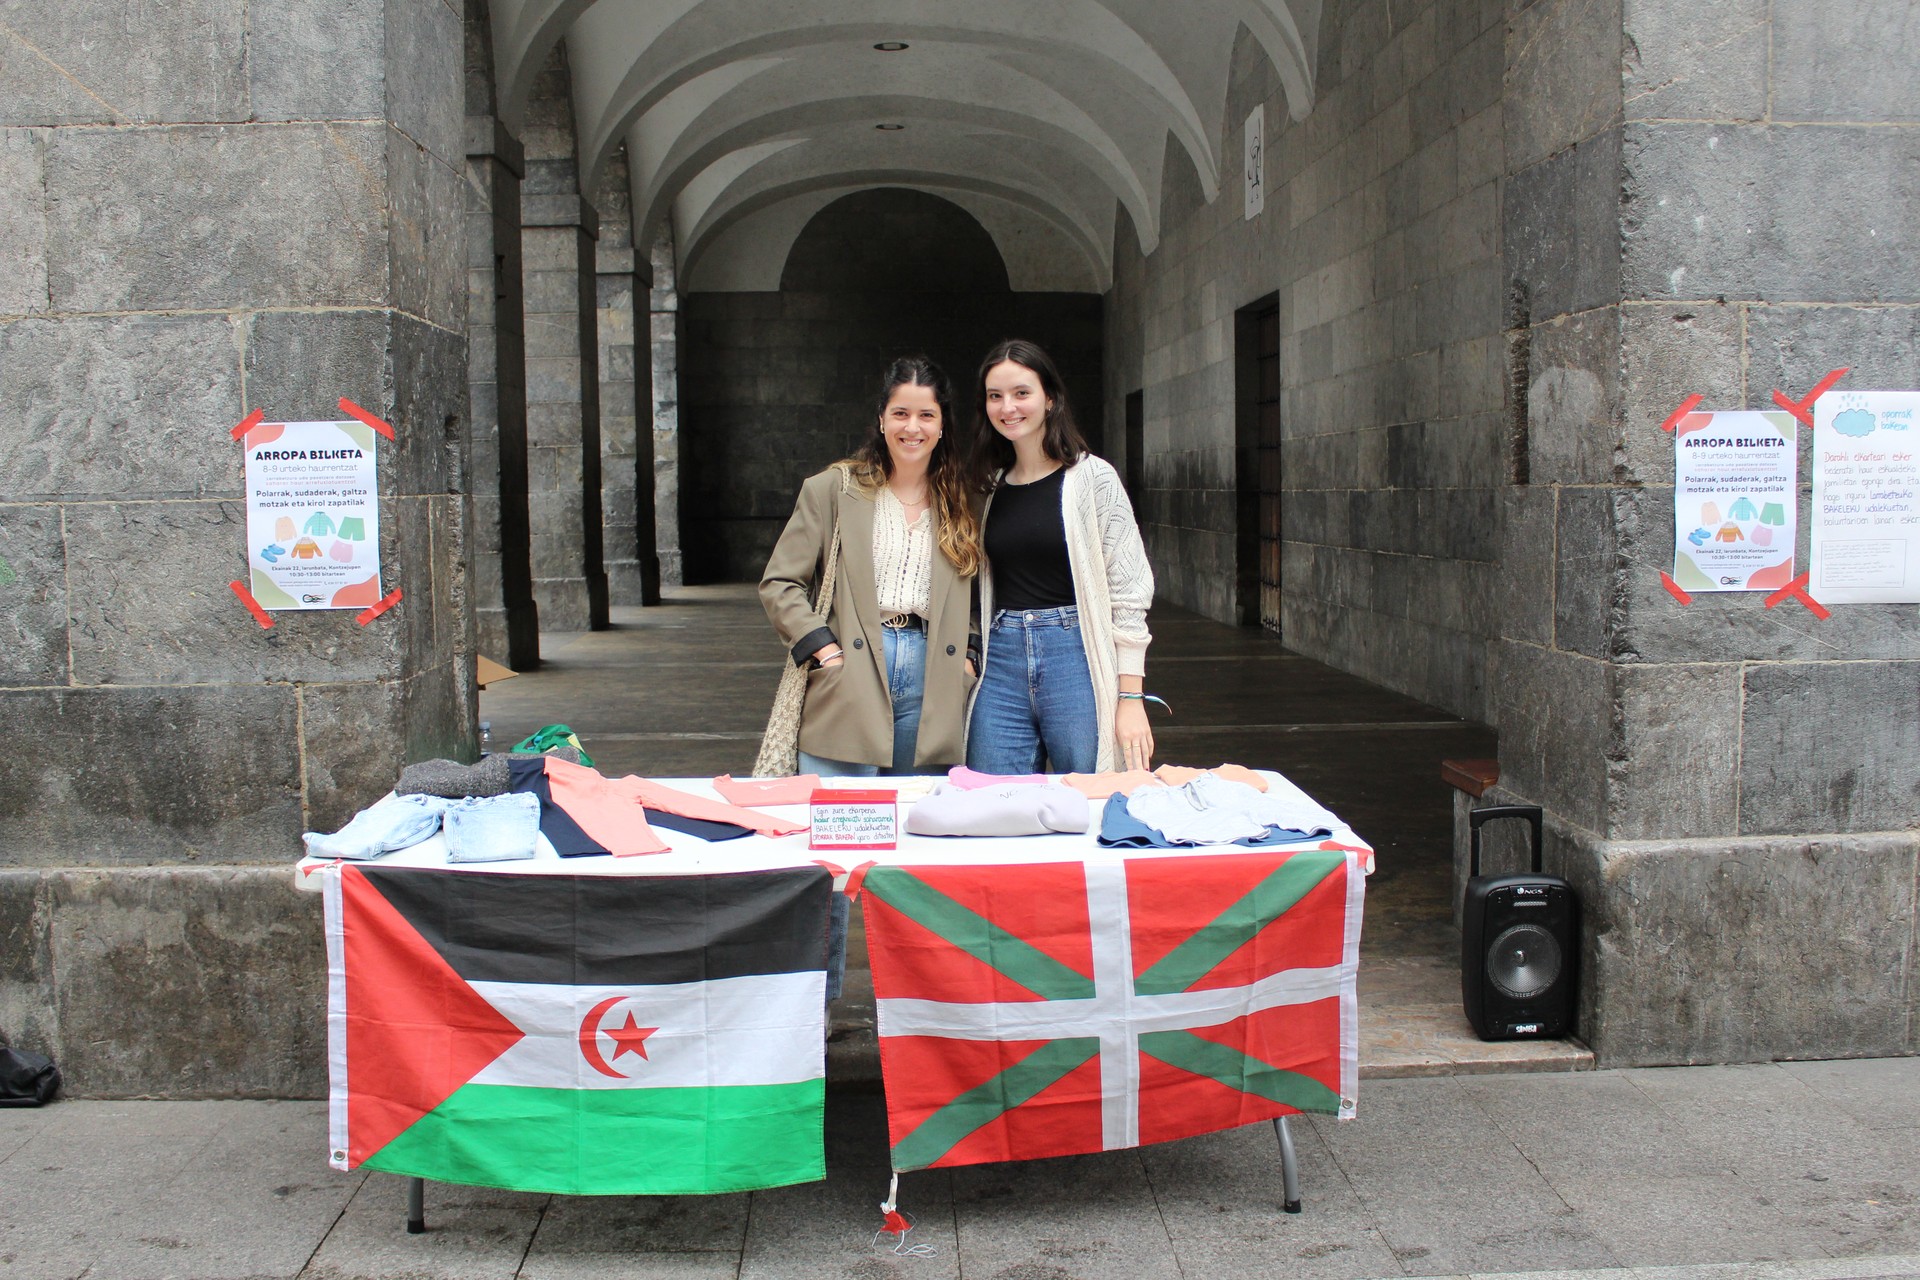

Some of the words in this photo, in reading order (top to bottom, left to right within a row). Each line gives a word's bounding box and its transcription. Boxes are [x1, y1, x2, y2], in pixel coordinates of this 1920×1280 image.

[1685, 438, 1733, 448] ARROPA
[1736, 438, 1785, 447] BILKETA
[255, 450, 307, 461] ARROPA
[310, 449, 363, 460] BILKETA
[1692, 452, 1706, 460] 8-9
[1735, 451, 1781, 459] haurrentzat
[263, 465, 278, 473] 8-9
[280, 464, 307, 472] urteko
[308, 464, 358, 472] haurrentzat
[1685, 476, 1719, 484] Polarrak,
[1720, 476, 1762, 484] sudaderak,
[1763, 475, 1787, 484] galtza
[256, 490, 293, 498] Polarrak,
[295, 489, 340, 497] sudaderak,
[341, 489, 368, 497] galtza
[1750, 485, 1784, 494] zapatilak
[307, 499, 326, 507] kirol
[328, 499, 365, 508] zapatilak
[815, 824, 852, 833] BAKELEKU
